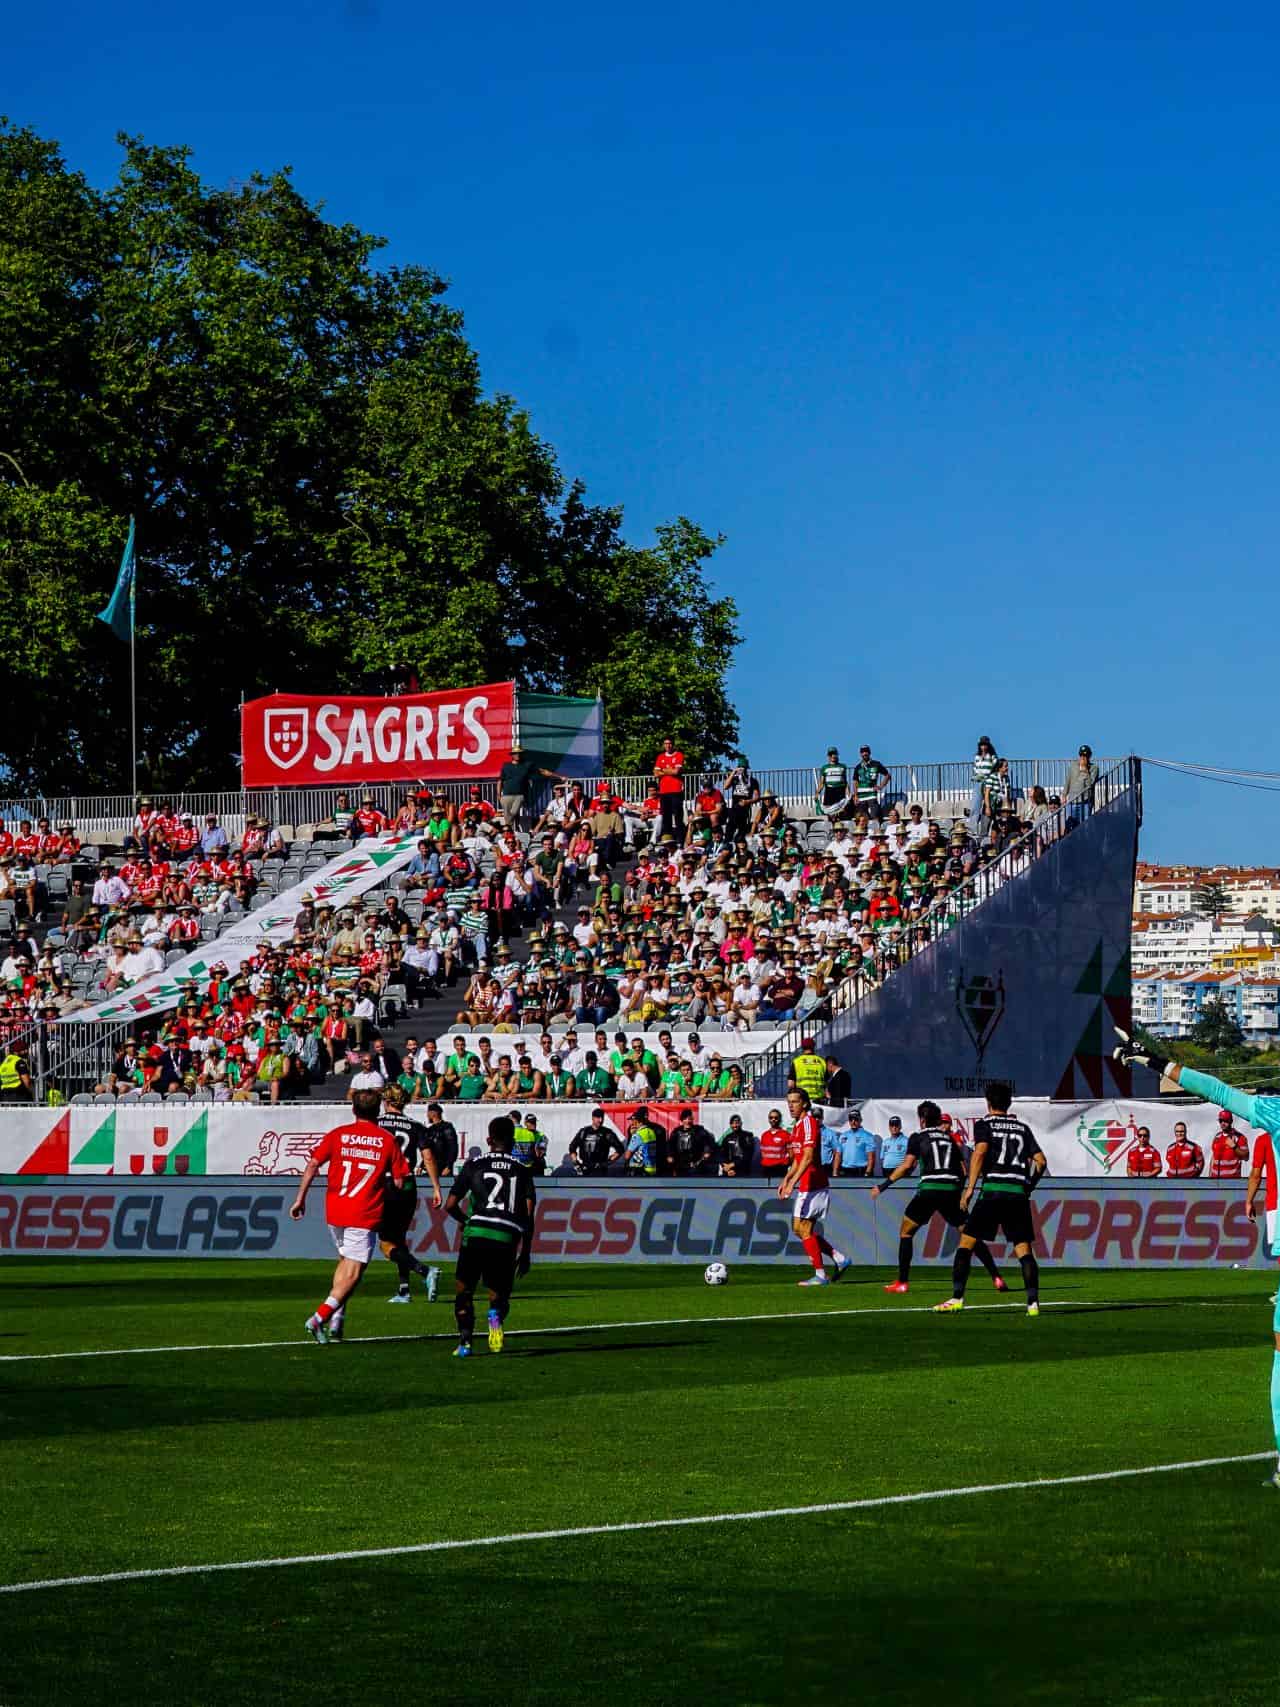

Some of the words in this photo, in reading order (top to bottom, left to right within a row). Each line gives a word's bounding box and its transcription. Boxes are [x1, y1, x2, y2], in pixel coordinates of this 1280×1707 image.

[313, 696, 491, 772] SAGRES
[349, 1133, 384, 1148] SAGRES
[931, 1140, 952, 1169] 17
[992, 1132, 1025, 1168] 72
[338, 1160, 376, 1198] 17
[491, 1161, 512, 1171] GENY
[483, 1172, 518, 1214] 21
